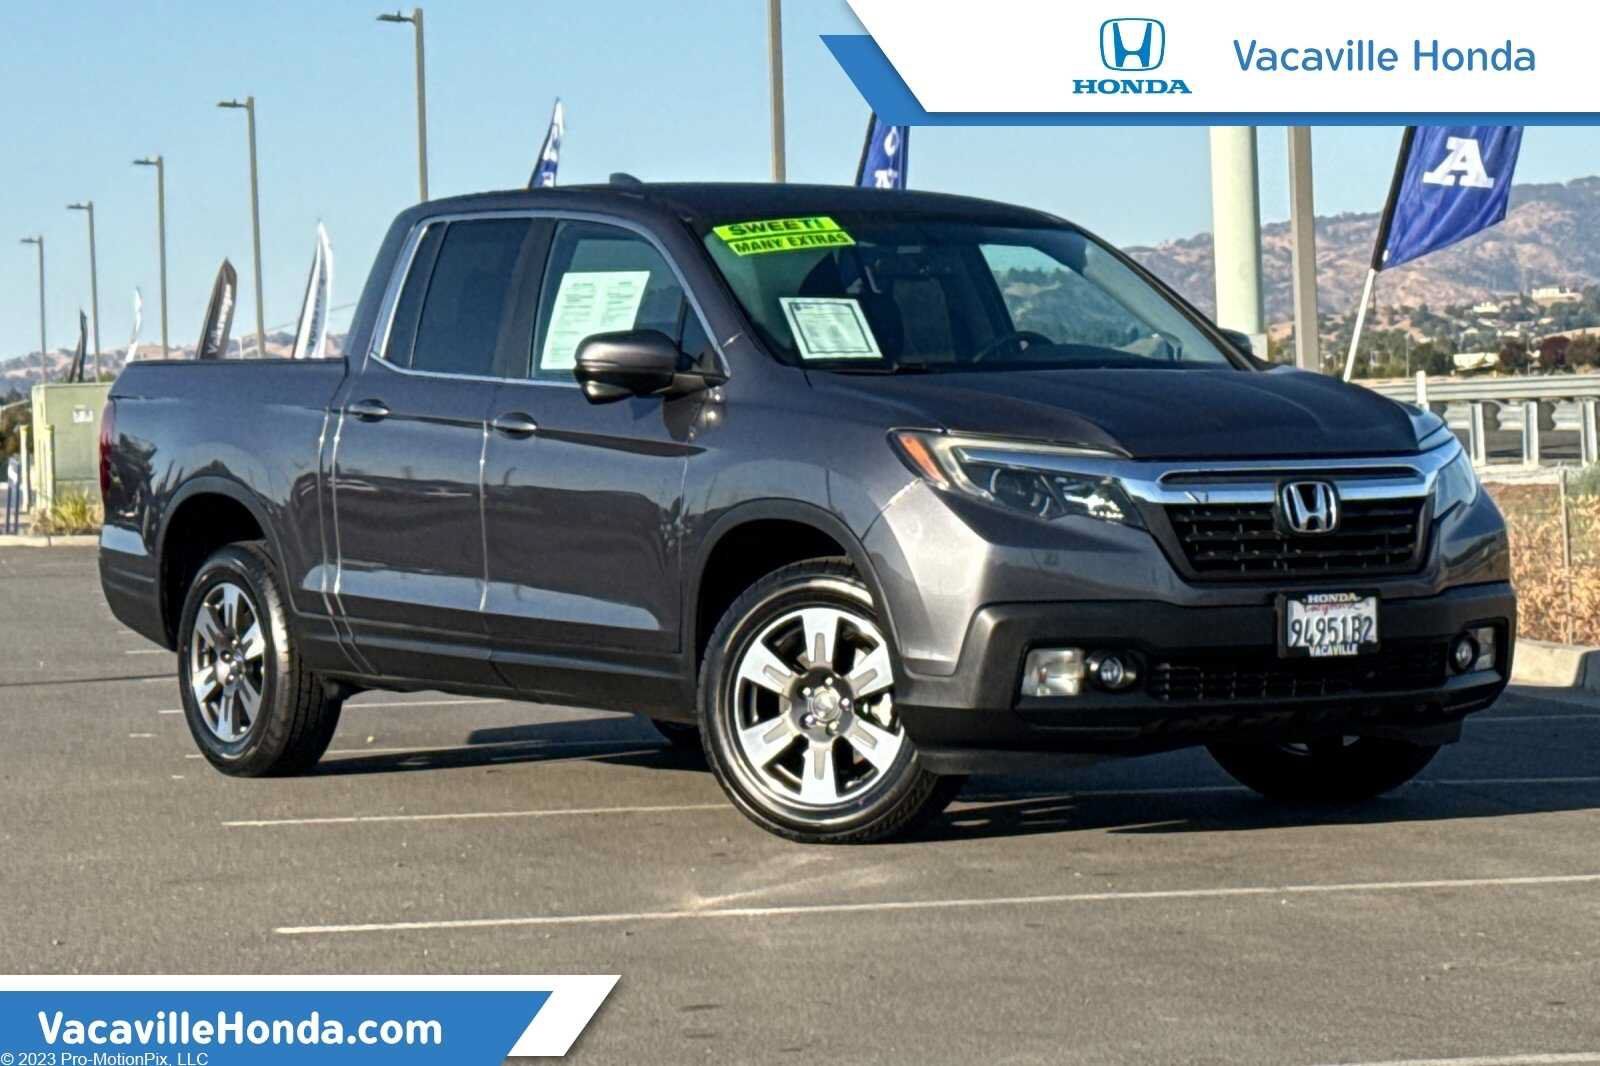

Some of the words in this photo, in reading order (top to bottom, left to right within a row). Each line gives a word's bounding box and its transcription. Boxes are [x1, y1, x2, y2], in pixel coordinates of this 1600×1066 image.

[728, 218, 825, 237] SWEET!
[734, 239, 783, 254] MANY
[788, 232, 849, 247] EXTRAS
[1307, 592, 1358, 603] HONDA
[1291, 615, 1373, 647] 94951B2
[1309, 642, 1359, 657] VACAVILLE
